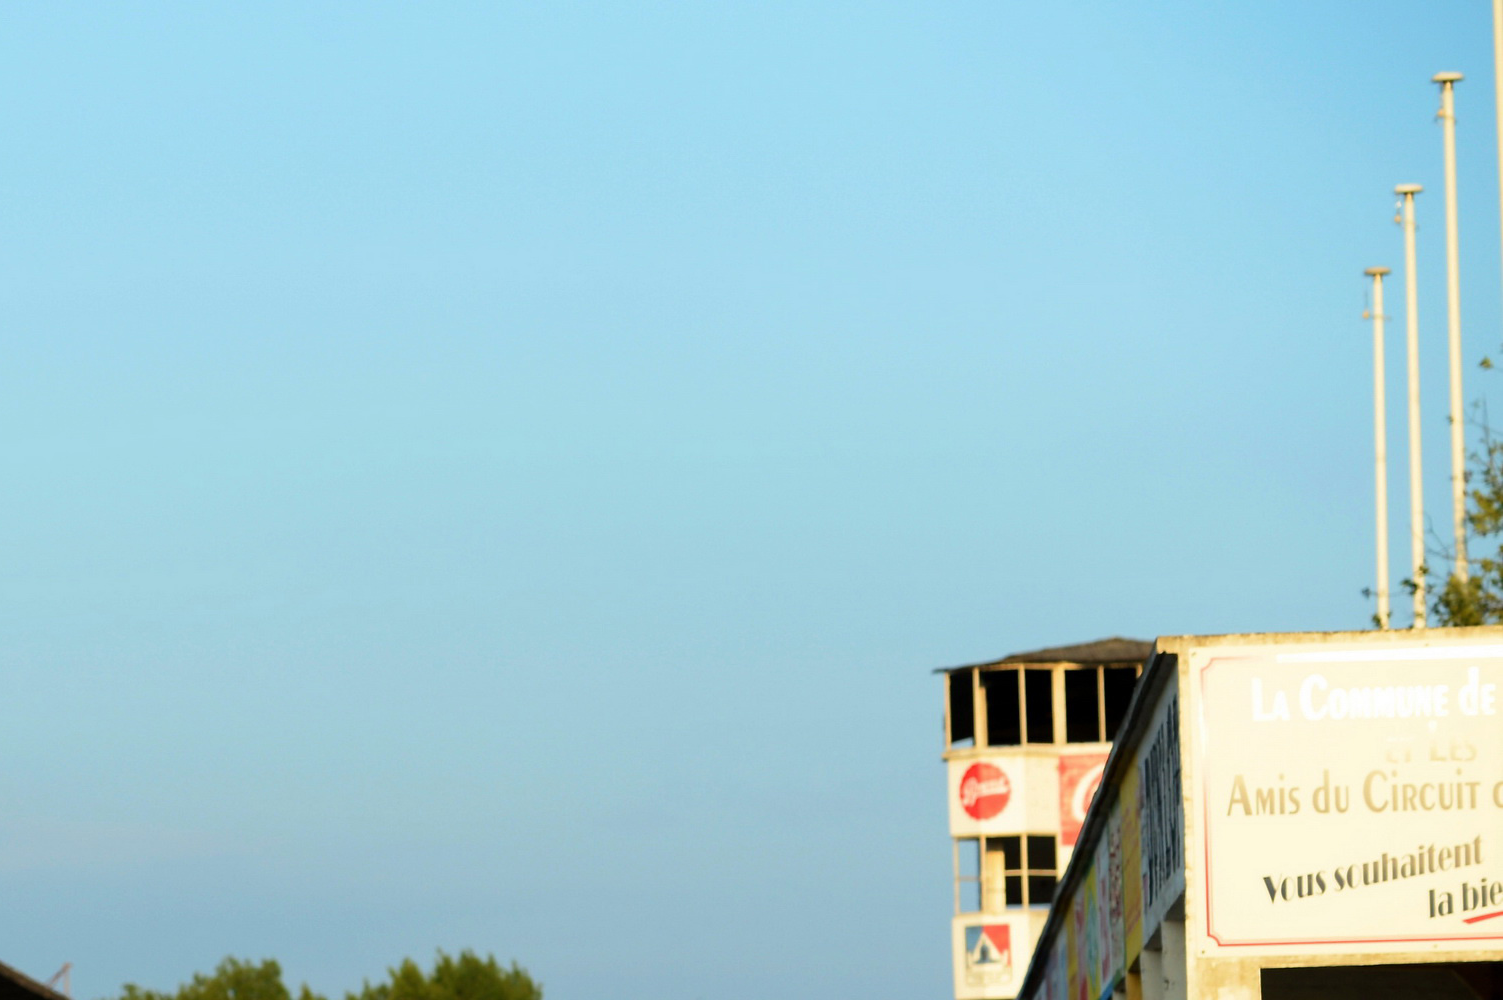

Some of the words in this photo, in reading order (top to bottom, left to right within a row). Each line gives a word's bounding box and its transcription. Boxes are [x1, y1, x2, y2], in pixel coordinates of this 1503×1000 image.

[1263, 869, 1327, 904] Vous
[1334, 834, 1484, 893] souhaitent
[1428, 889, 1454, 918] la
